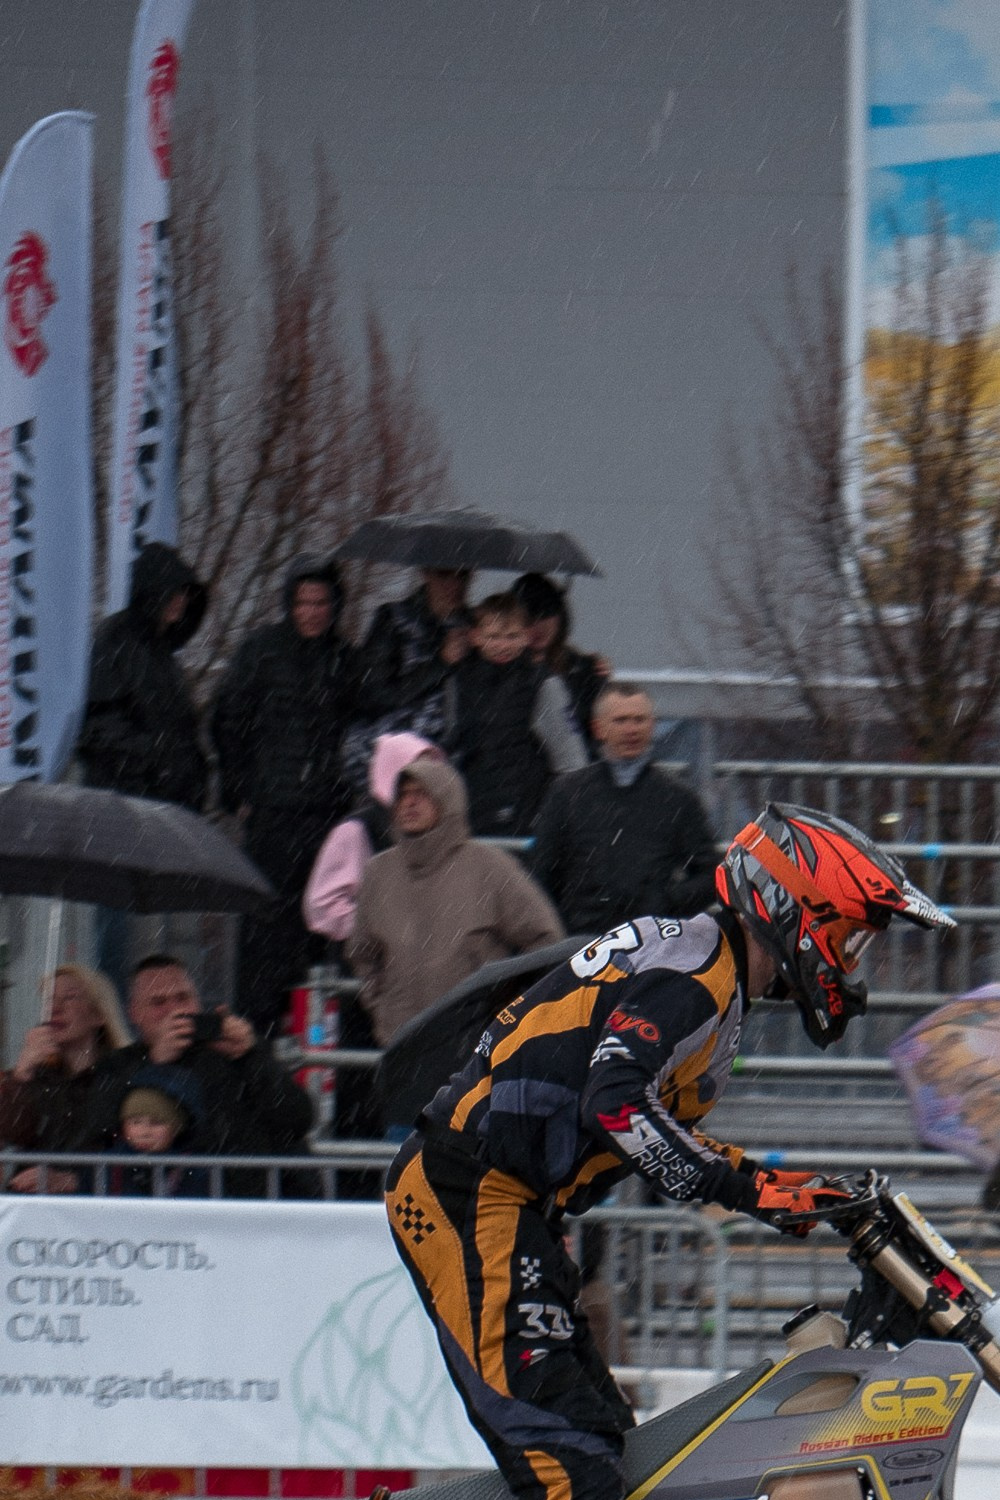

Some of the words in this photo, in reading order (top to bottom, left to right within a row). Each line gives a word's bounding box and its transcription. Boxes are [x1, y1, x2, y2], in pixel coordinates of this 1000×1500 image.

[6, 1237, 216, 1271] СКОРОСТЬ.
[6, 1274, 142, 1307] СТИЛЬ.
[0, 1369, 280, 1409] www.gardens.ru
[861, 1372, 976, 1422] GR7
[800, 1438, 849, 1453] Russian
[853, 1431, 895, 1445] Riders
[899, 1425, 945, 1439] Edition
